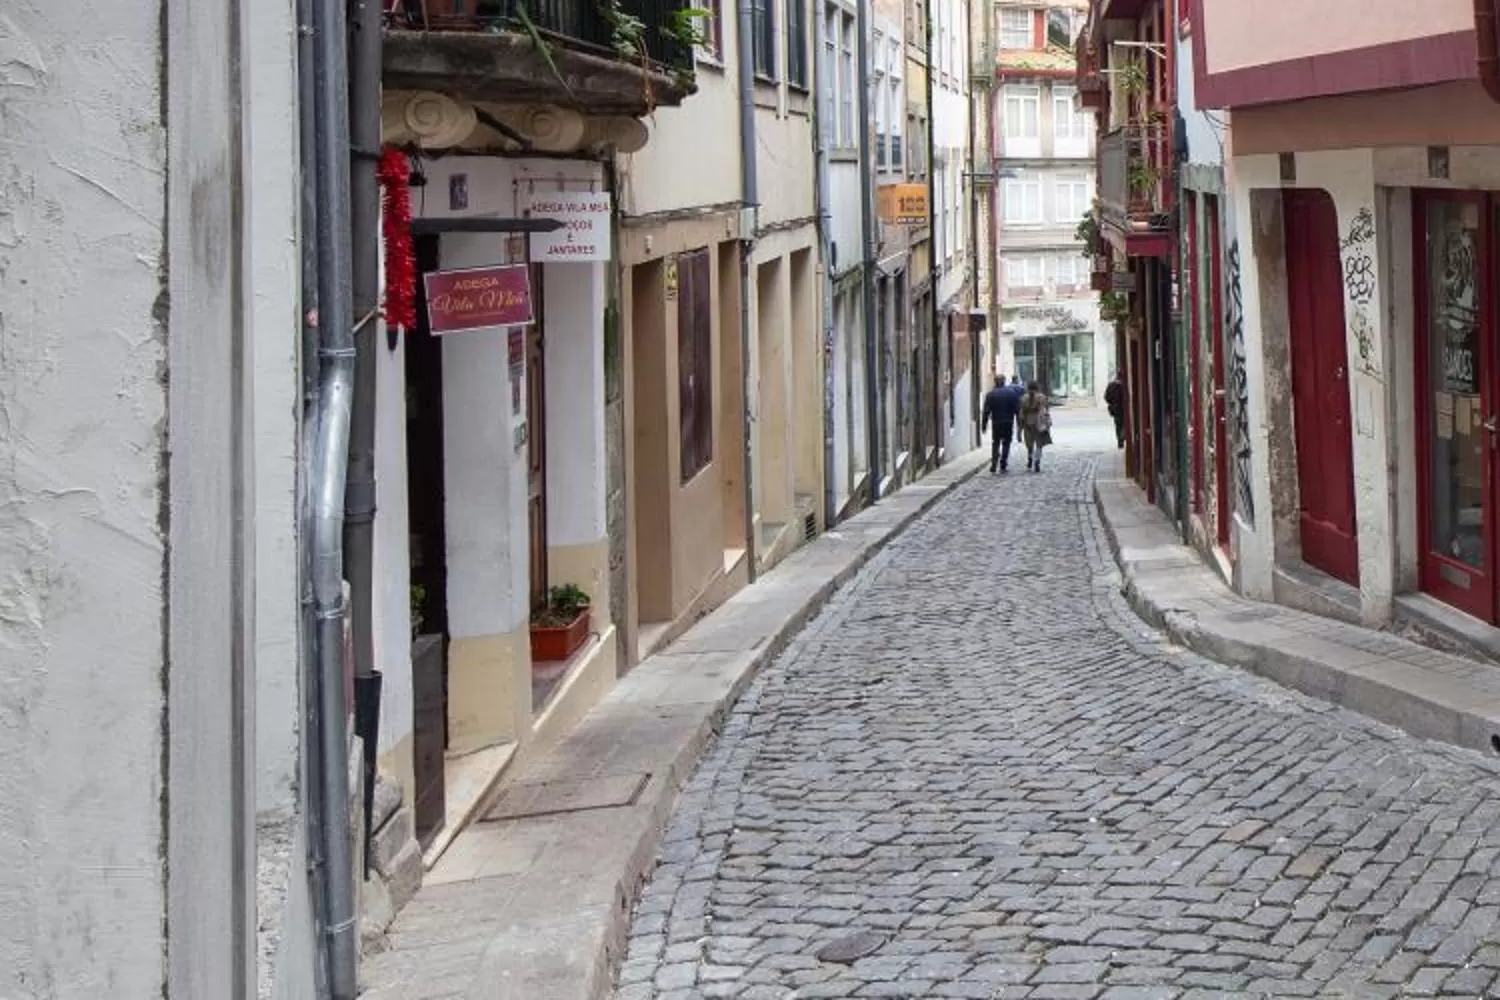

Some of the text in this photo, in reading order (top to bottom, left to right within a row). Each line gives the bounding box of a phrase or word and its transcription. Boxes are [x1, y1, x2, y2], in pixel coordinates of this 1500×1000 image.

[531, 202, 563, 213] ADEGA
[565, 202, 587, 213] VILA
[546, 244, 597, 256] JANTARES
[453, 277, 499, 291] ADEGA
